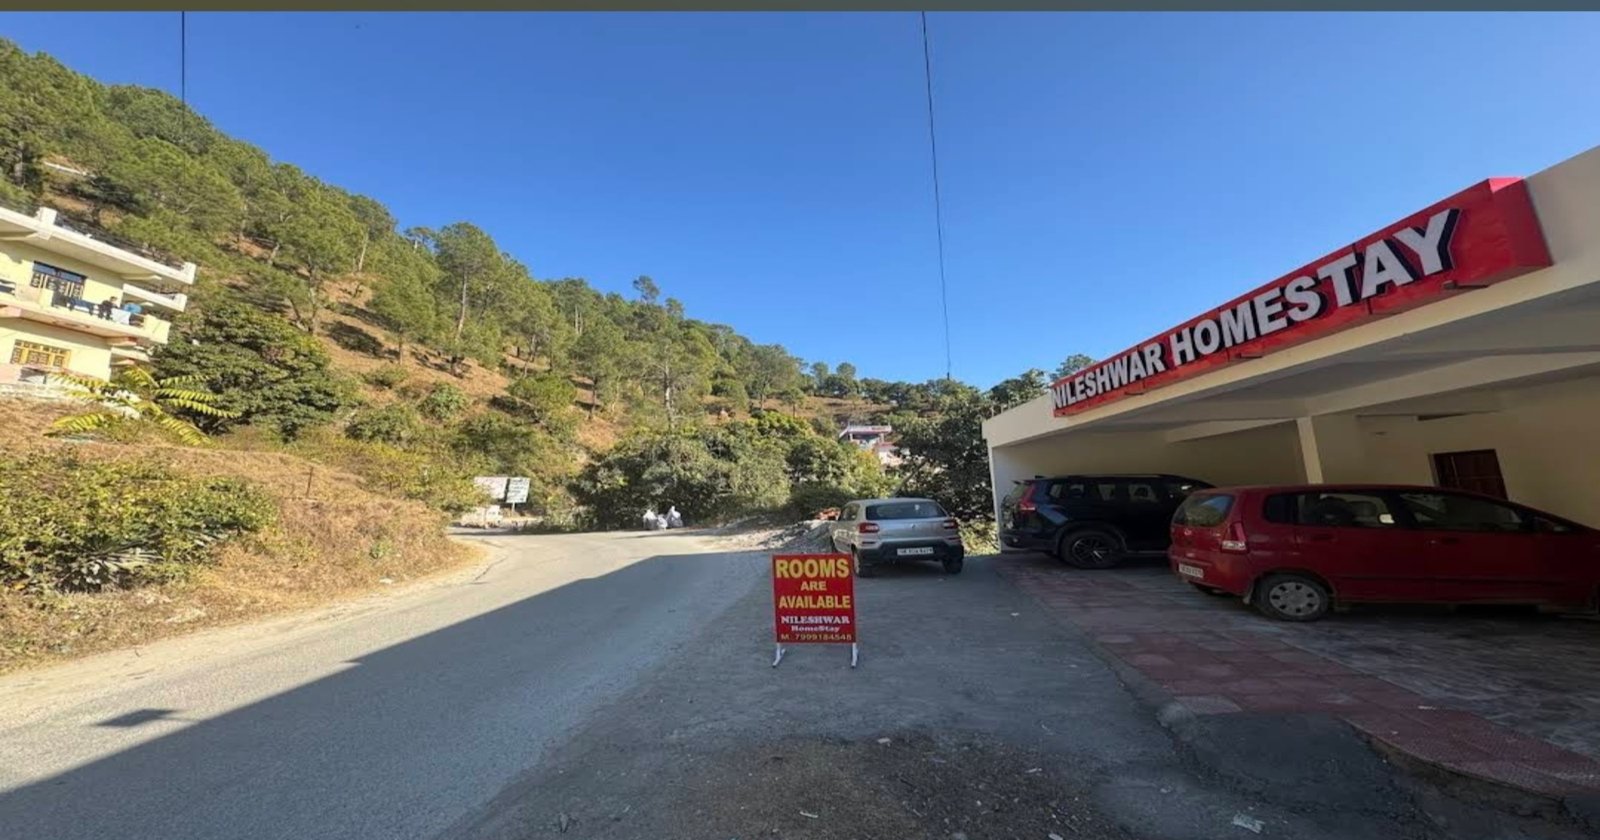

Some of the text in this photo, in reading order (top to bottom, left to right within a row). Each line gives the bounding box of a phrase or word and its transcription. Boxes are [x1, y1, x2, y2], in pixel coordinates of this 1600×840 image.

[1051, 208, 1461, 409] NILESHWAR HOMESTAY
[775, 558, 850, 579] ROOMS
[800, 581, 827, 591] ARE
[778, 595, 851, 609] AVAILABLE
[780, 615, 850, 625] NILESHWAR
